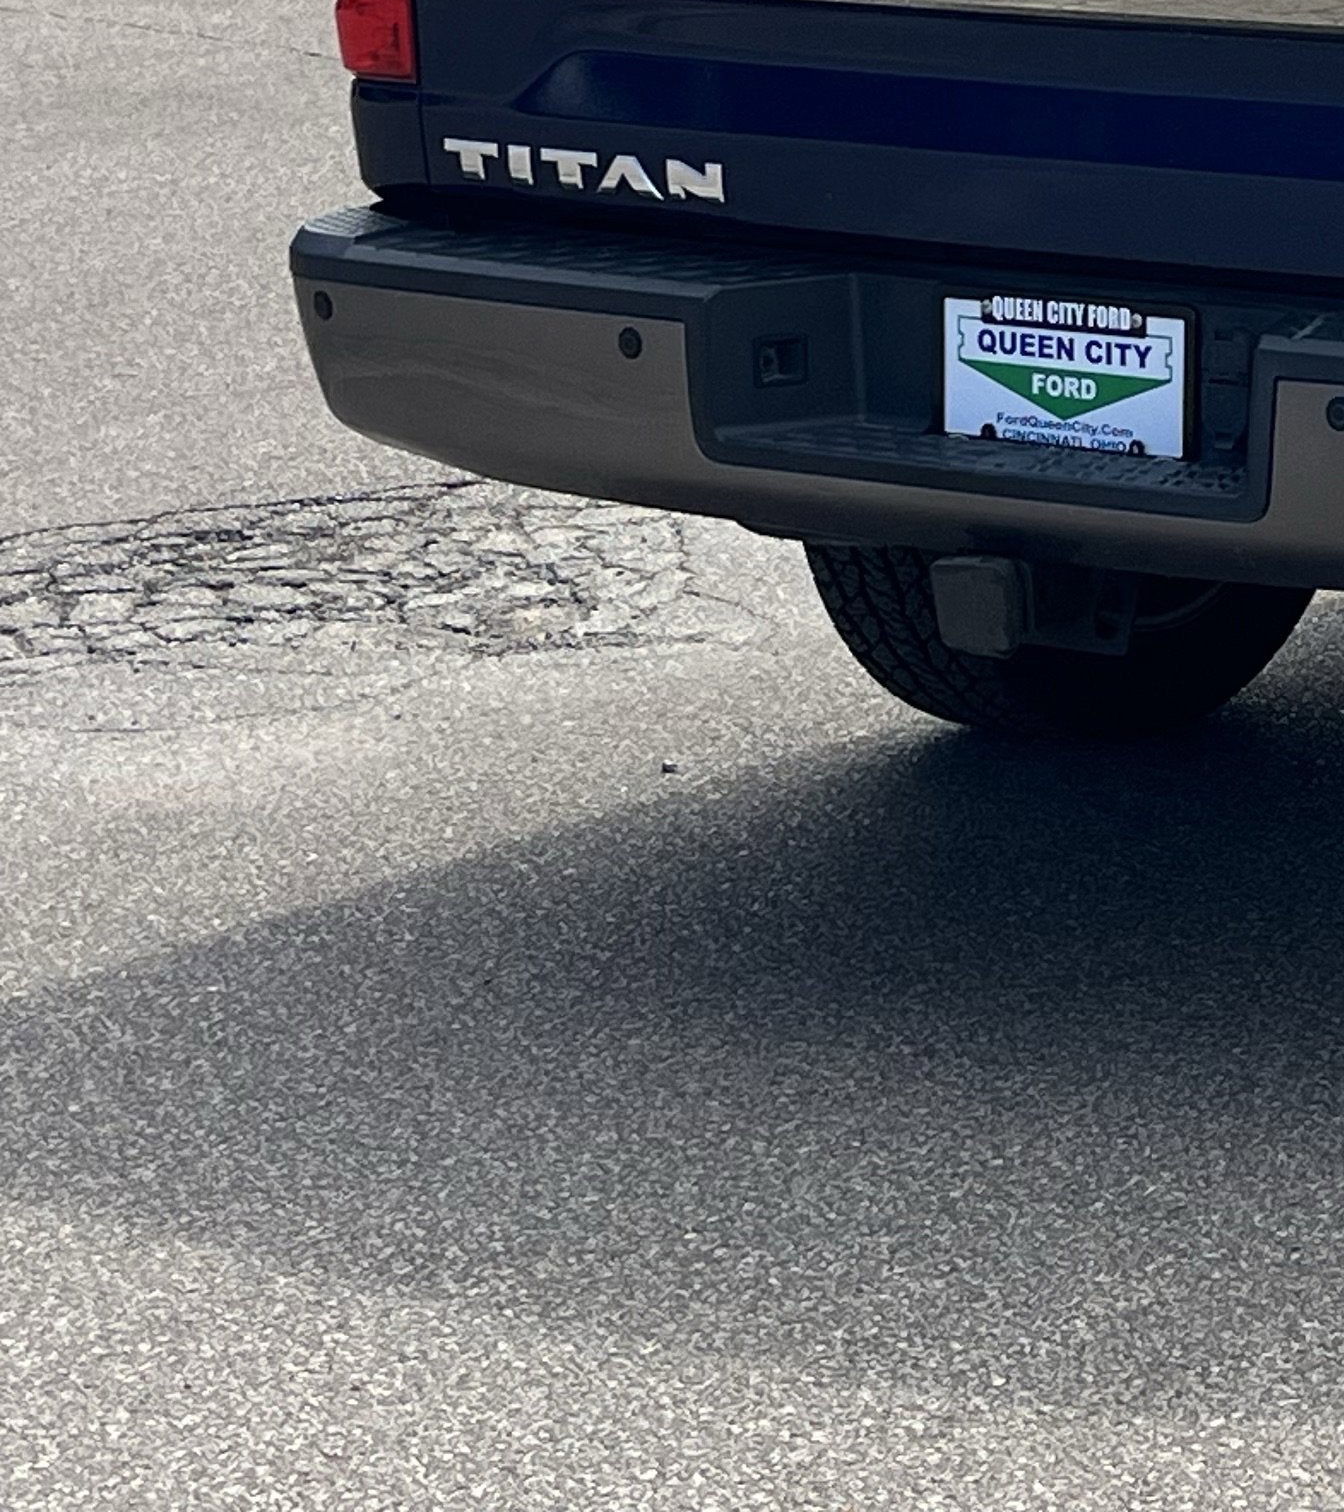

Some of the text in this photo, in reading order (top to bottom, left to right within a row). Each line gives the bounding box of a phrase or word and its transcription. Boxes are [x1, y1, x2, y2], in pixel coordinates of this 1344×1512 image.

[443, 138, 726, 203] TITAN
[991, 296, 1131, 331] QUEEN CITY FORD
[976, 329, 1153, 369] QUEEN CITY
[1031, 372, 1098, 401] FORD
